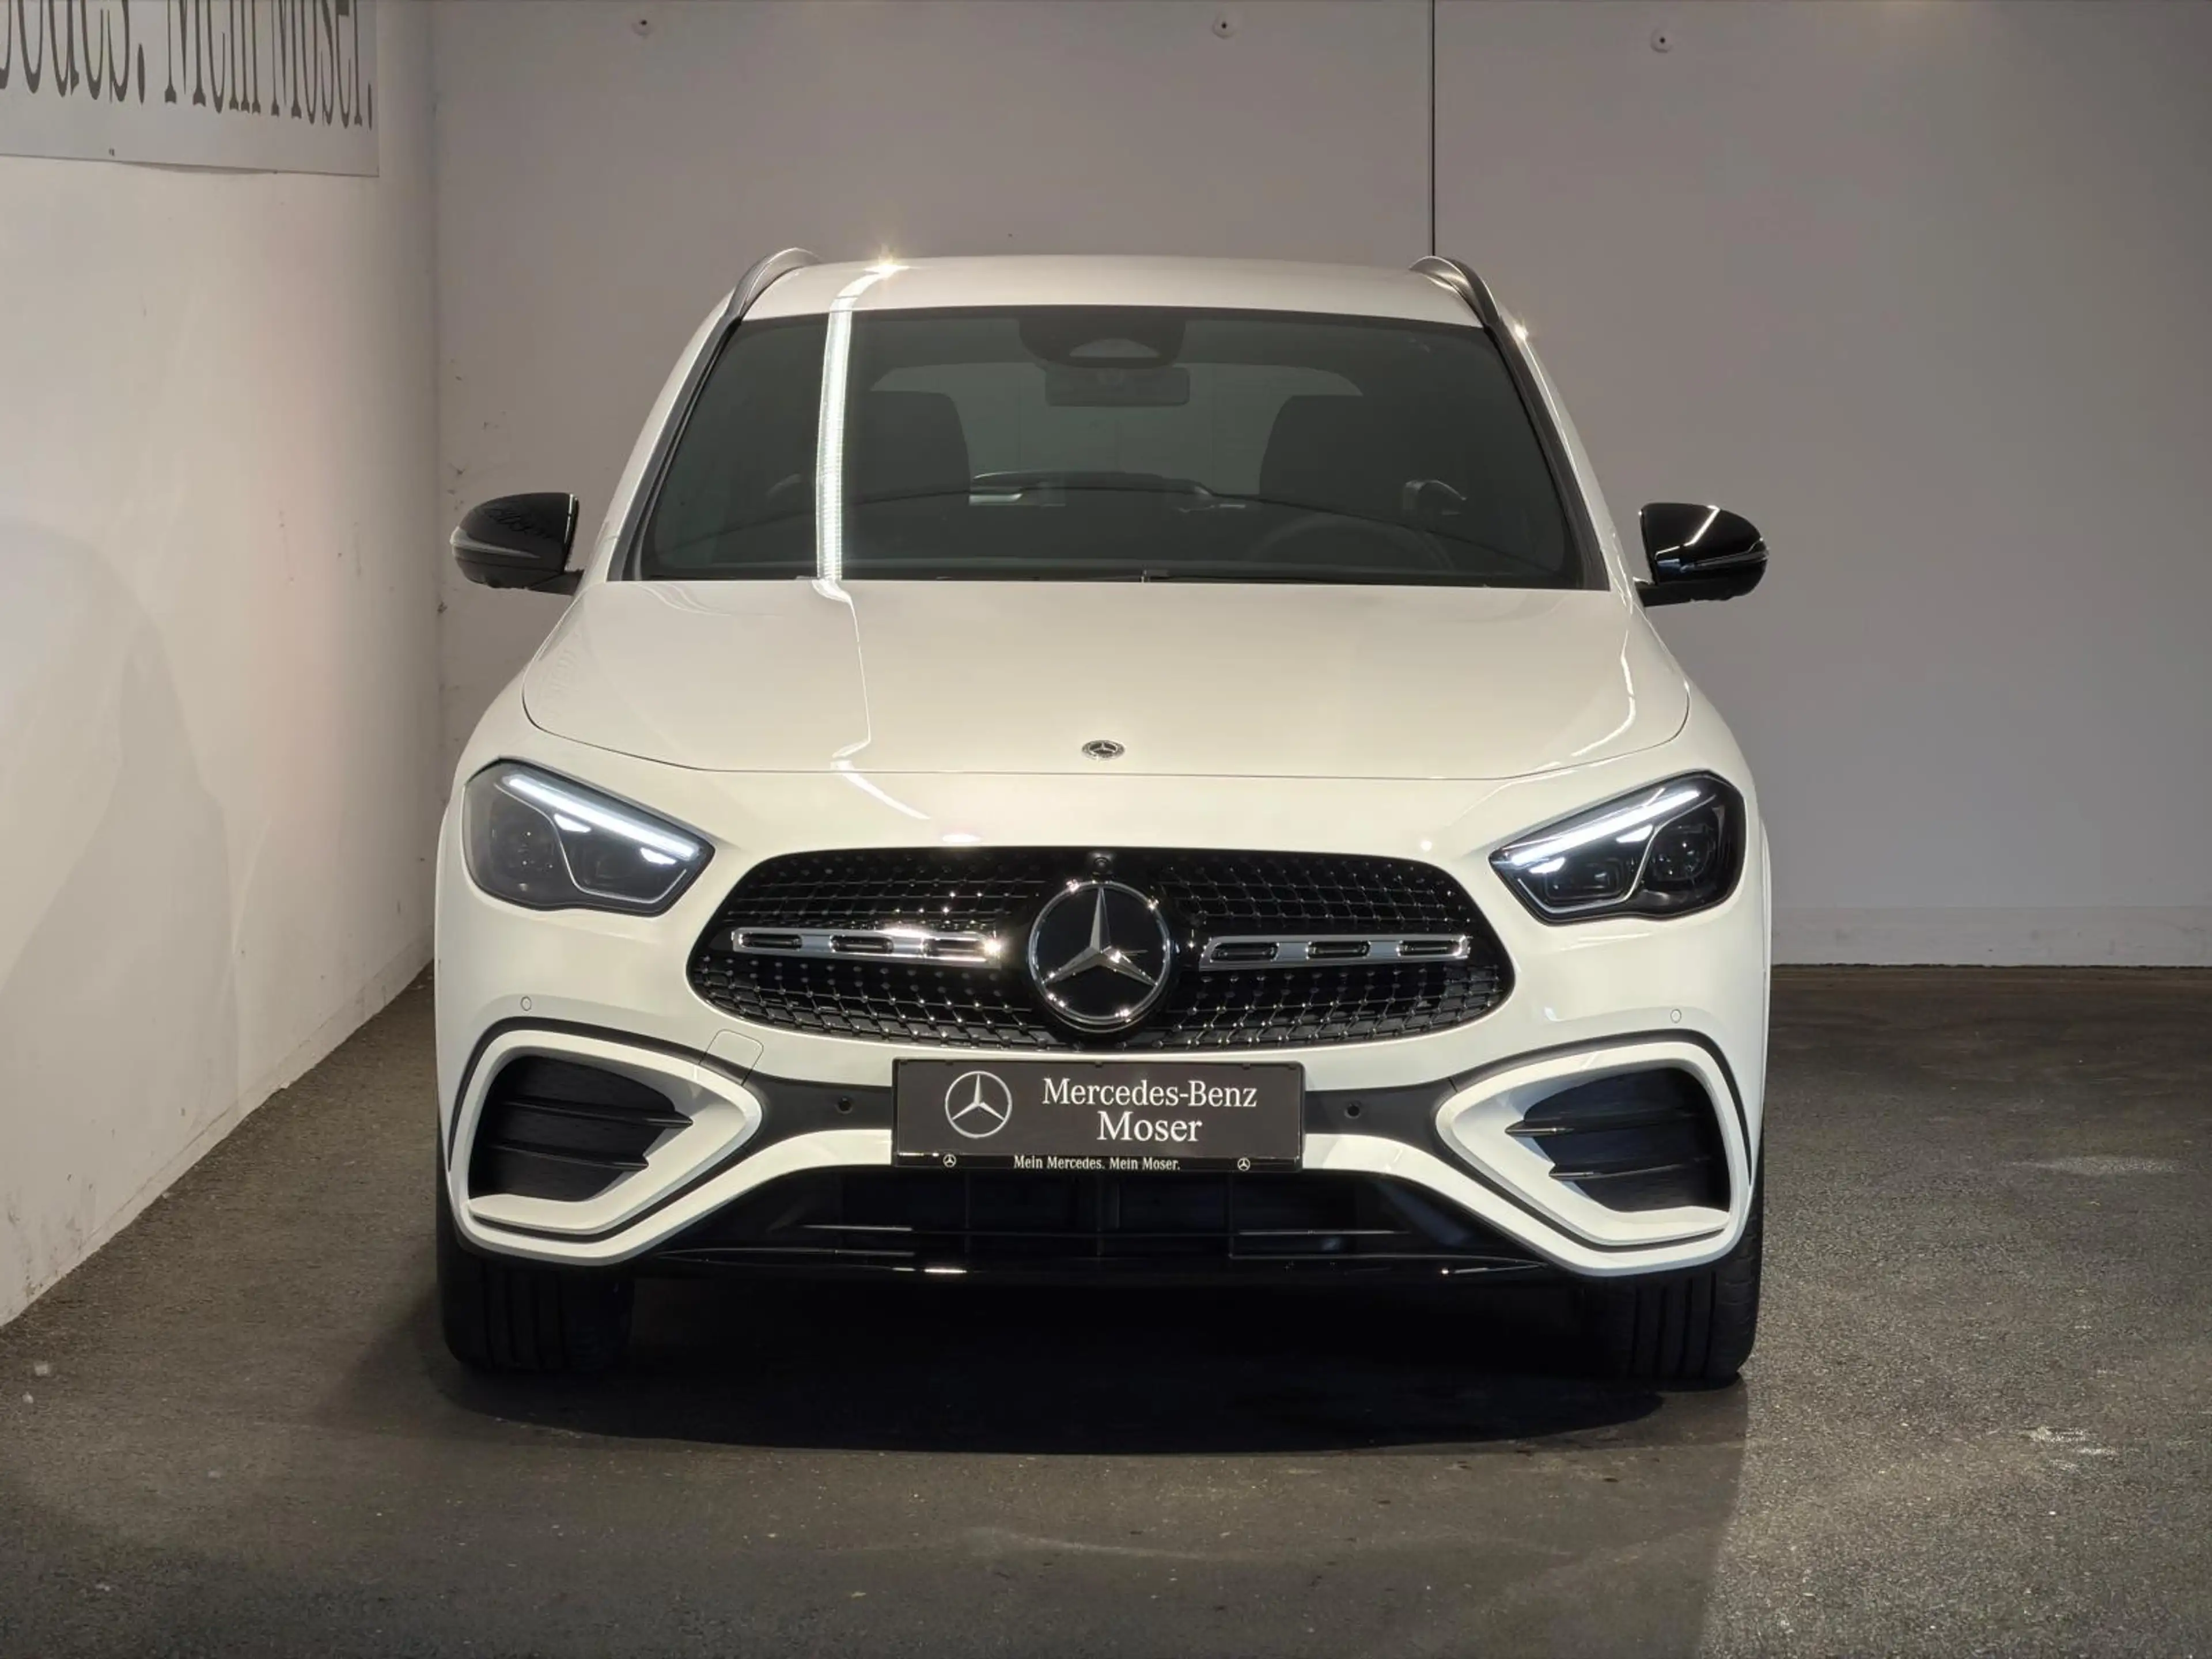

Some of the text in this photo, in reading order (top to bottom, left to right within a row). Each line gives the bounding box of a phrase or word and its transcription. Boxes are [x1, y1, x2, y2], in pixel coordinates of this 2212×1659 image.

[1042, 1078, 1257, 1107] Mercedes-Benz
[1096, 1111, 1203, 1142] Moser
[1014, 1155, 1180, 1171] Mein Mercedes. Mein Moser.
